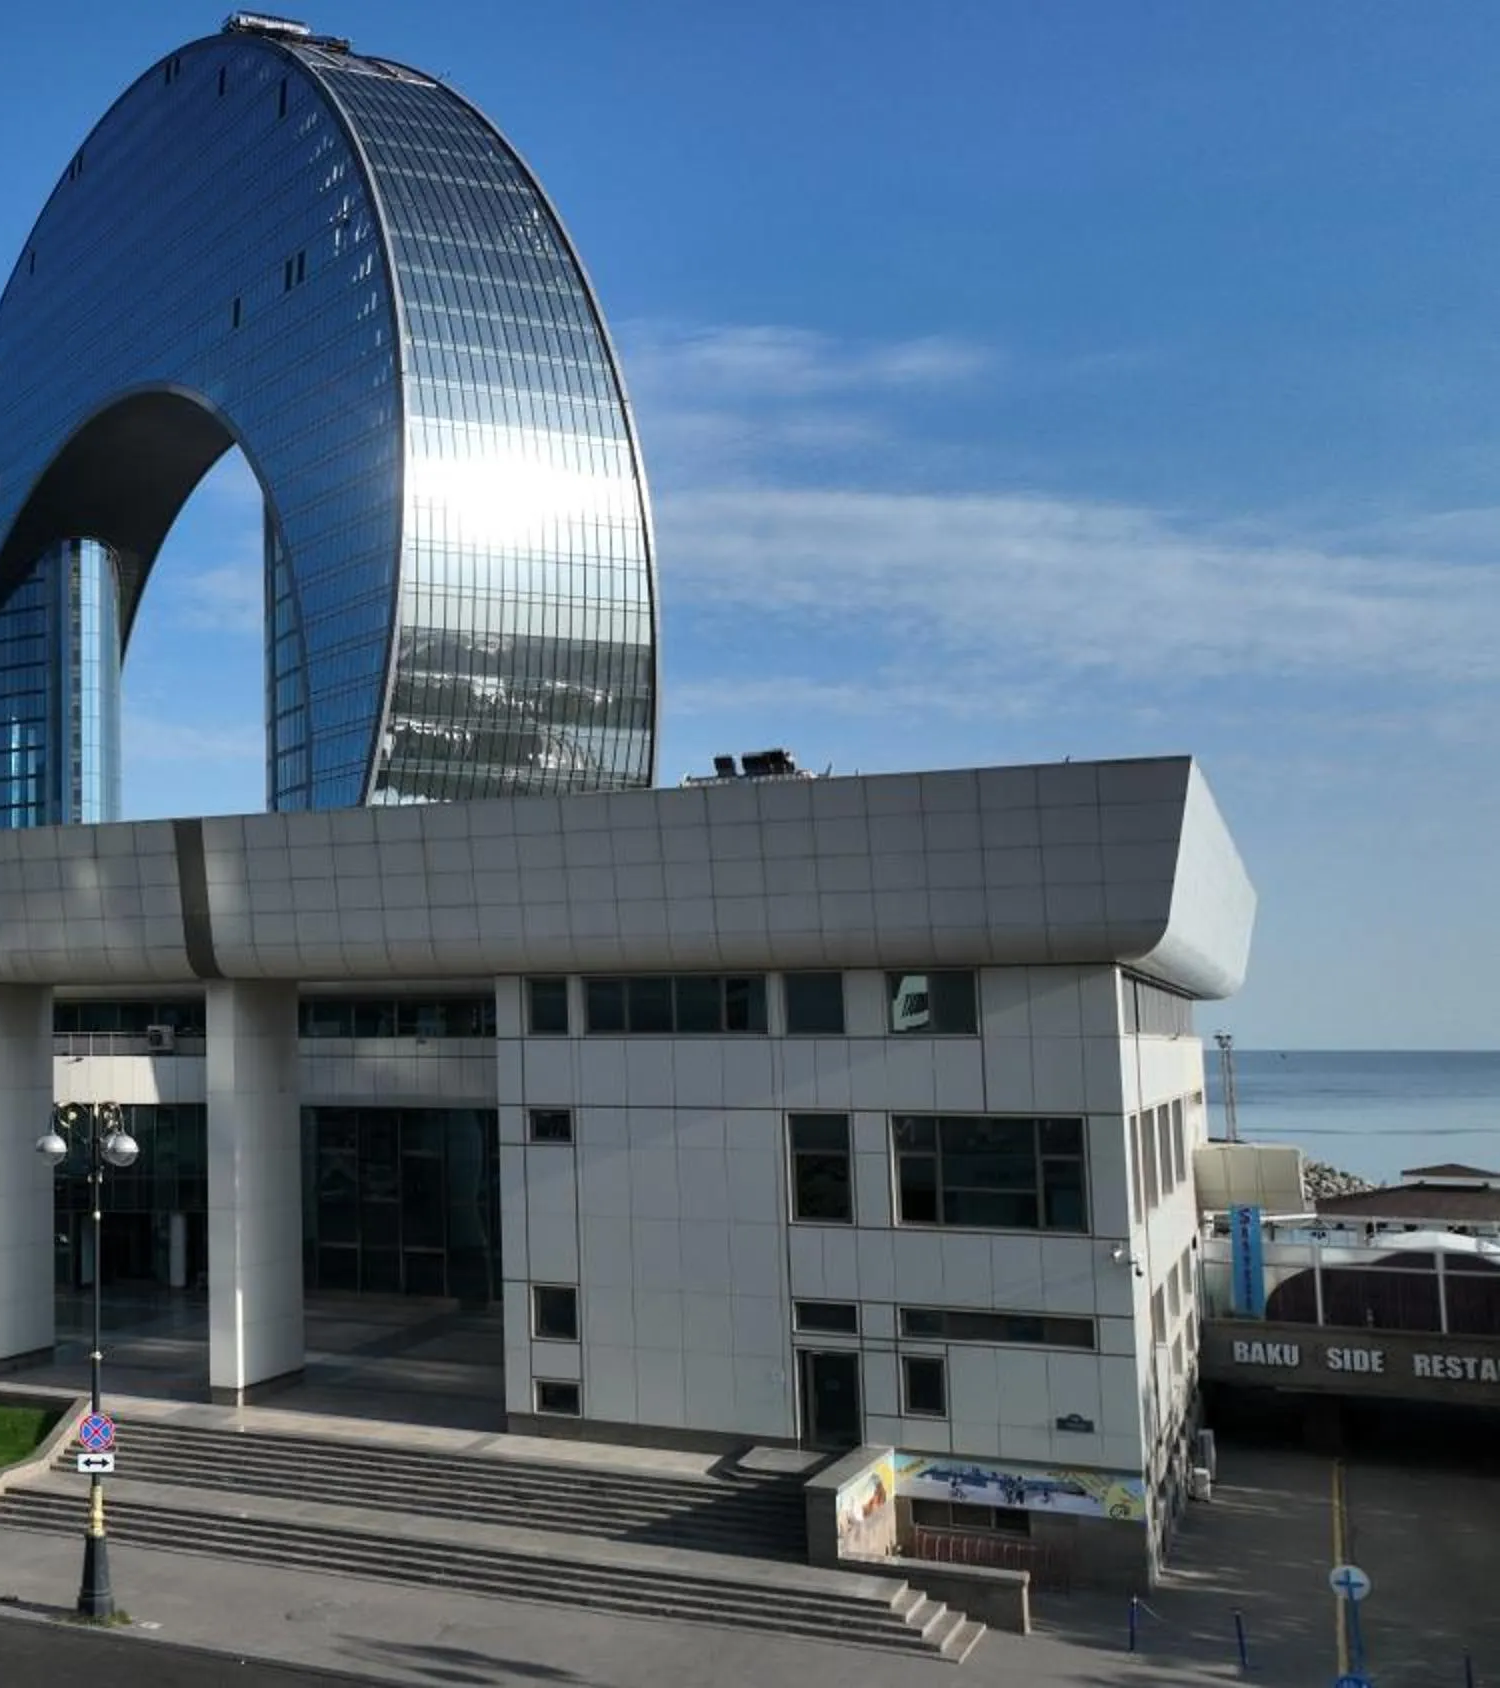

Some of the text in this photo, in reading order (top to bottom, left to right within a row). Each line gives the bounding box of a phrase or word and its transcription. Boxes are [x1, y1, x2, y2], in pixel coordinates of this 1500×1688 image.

[1233, 1340, 1500, 1383] BAKU SIDE RESTA
